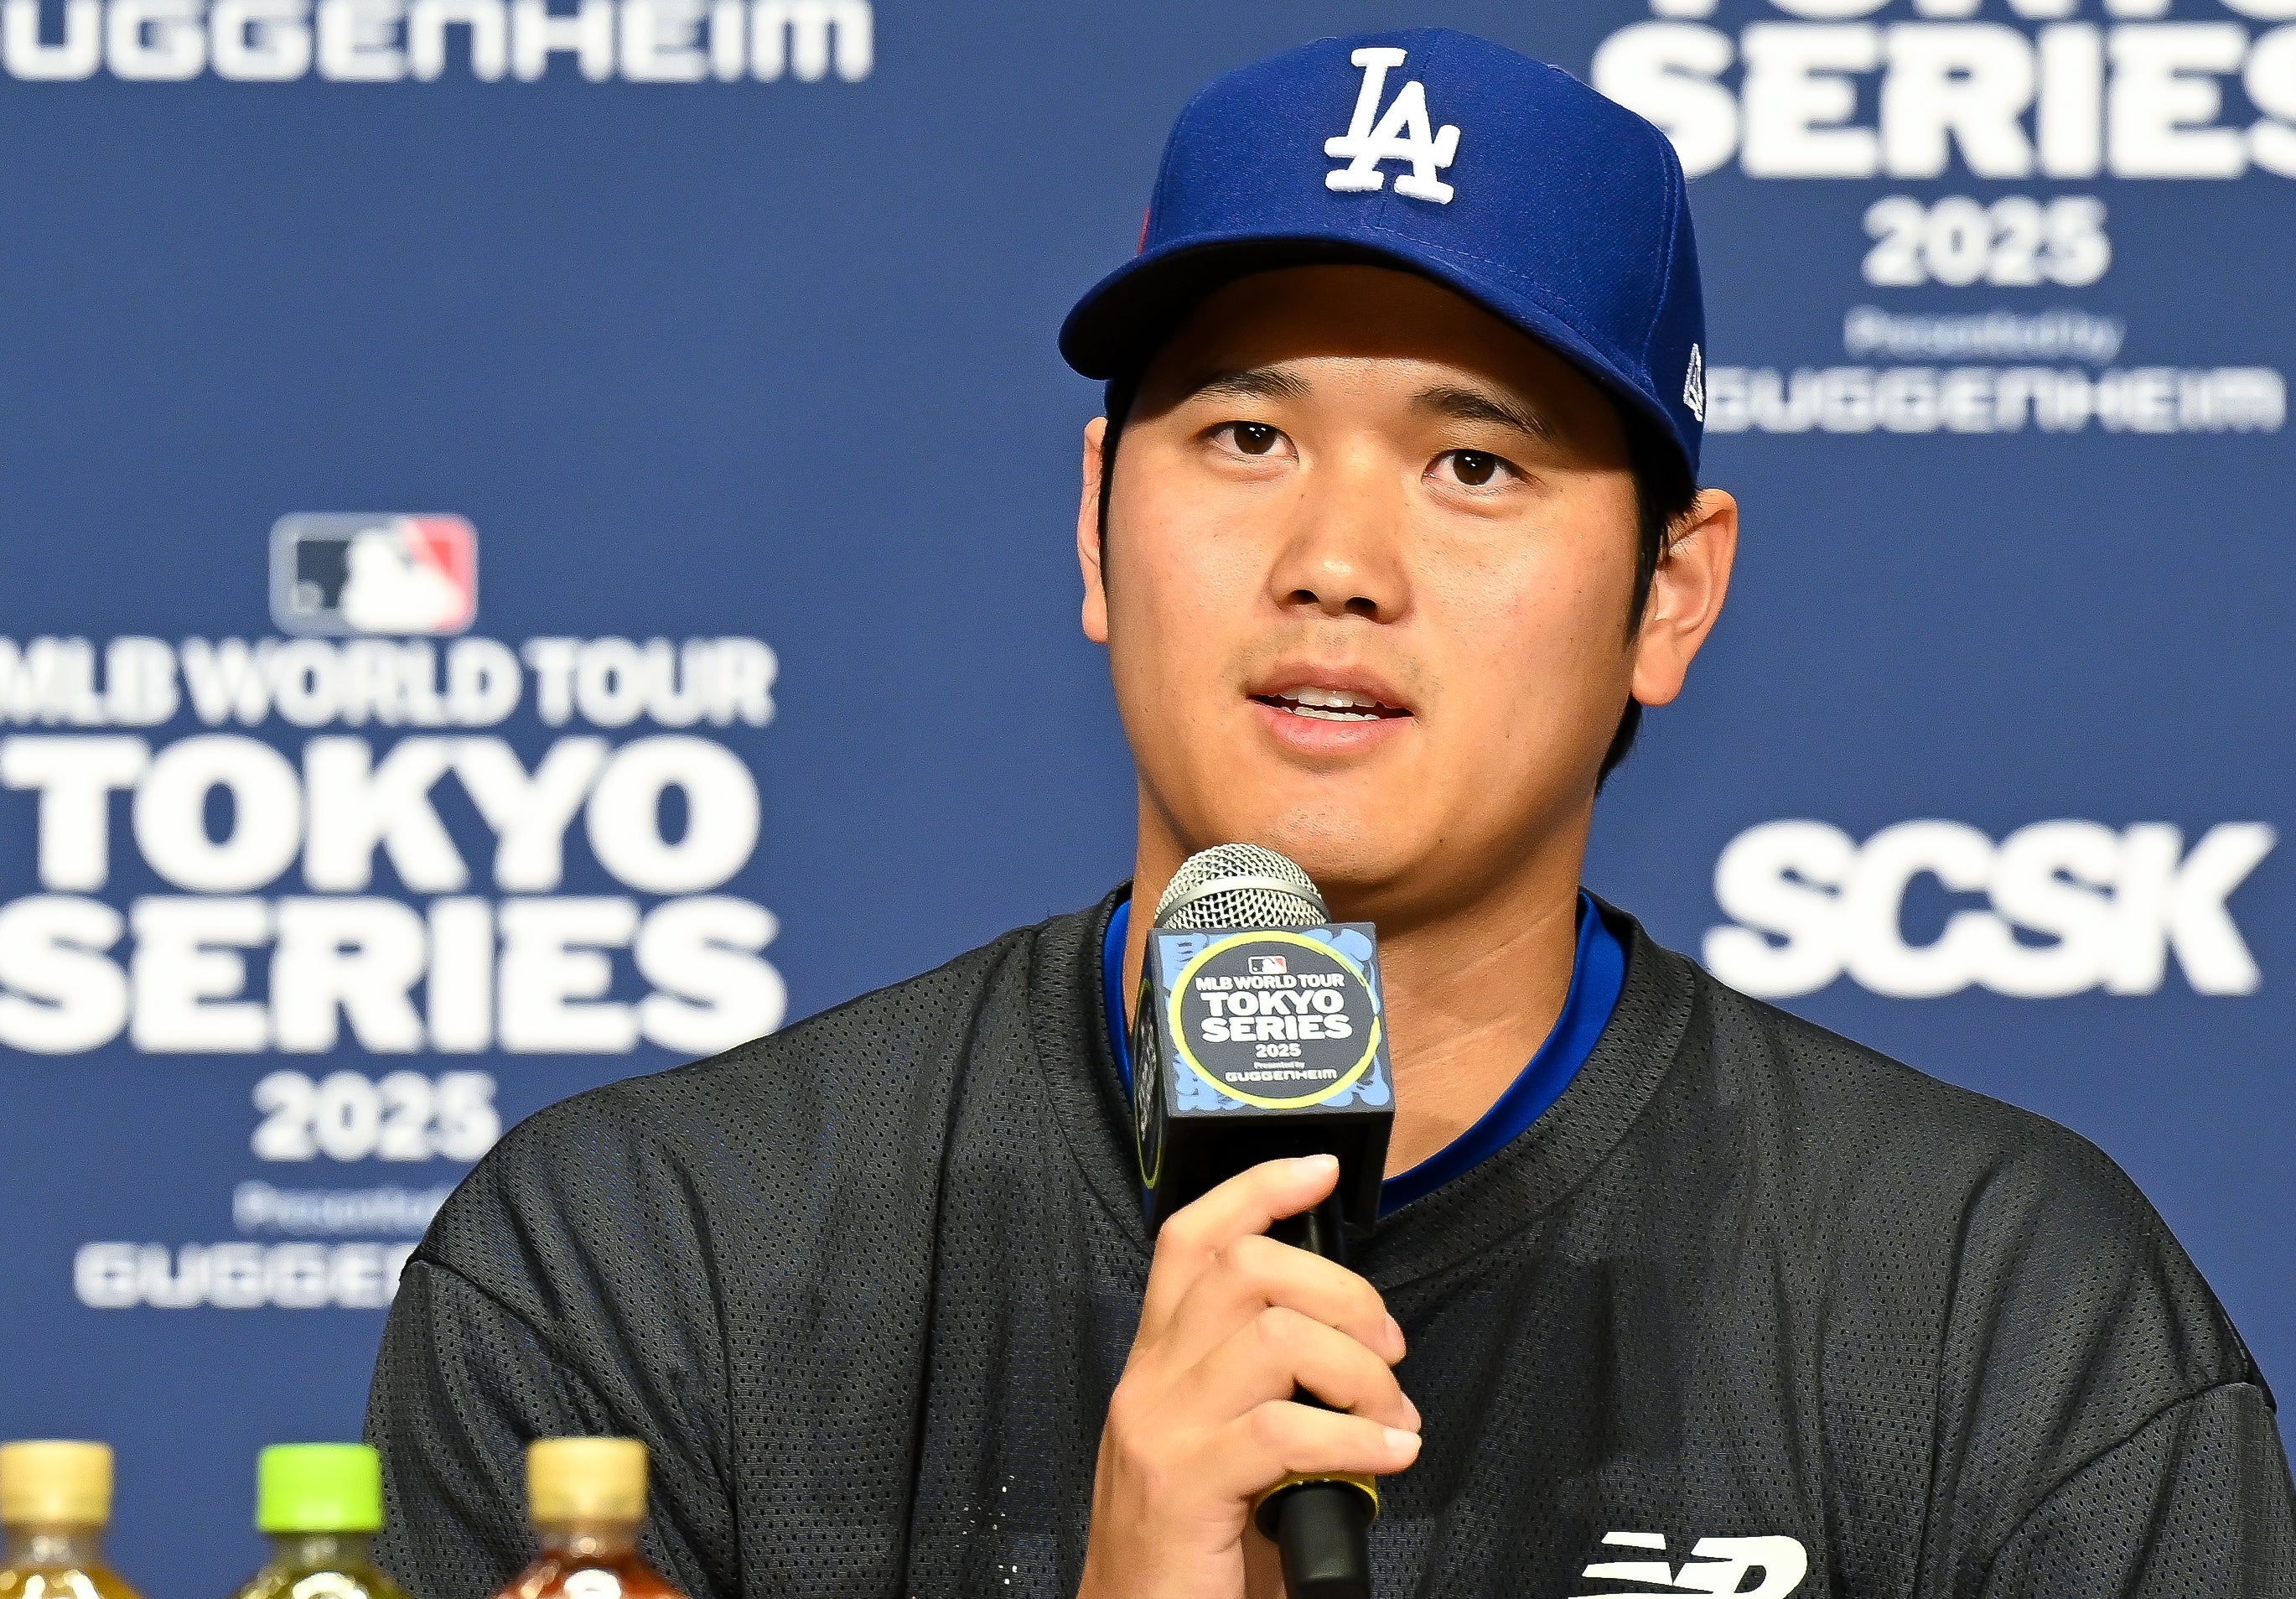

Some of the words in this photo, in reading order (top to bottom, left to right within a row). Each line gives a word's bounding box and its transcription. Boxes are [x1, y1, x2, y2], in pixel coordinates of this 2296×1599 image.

[1324, 47, 1461, 205] LA
[1863, 195, 2112, 288] 2025
[1706, 366, 2287, 434] GUGGENHEIM
[0, 636, 178, 727] MLB
[179, 636, 521, 728] WORLD
[524, 636, 778, 728] TOUR
[1, 734, 761, 894] TOKYO
[1702, 818, 2277, 999] SCSK
[0, 894, 787, 1055] SERIES
[1195, 976, 1234, 991] MLB
[1233, 974, 1297, 990] WORLD
[1297, 973, 1345, 989] TOUR
[1200, 989, 1345, 1017] TOKYO
[1200, 1014, 1353, 1043] SERIES
[1256, 1043, 1302, 1058] 2025
[251, 1070, 501, 1163] 2025
[1225, 1068, 1338, 1082] GUGGENHEIM
